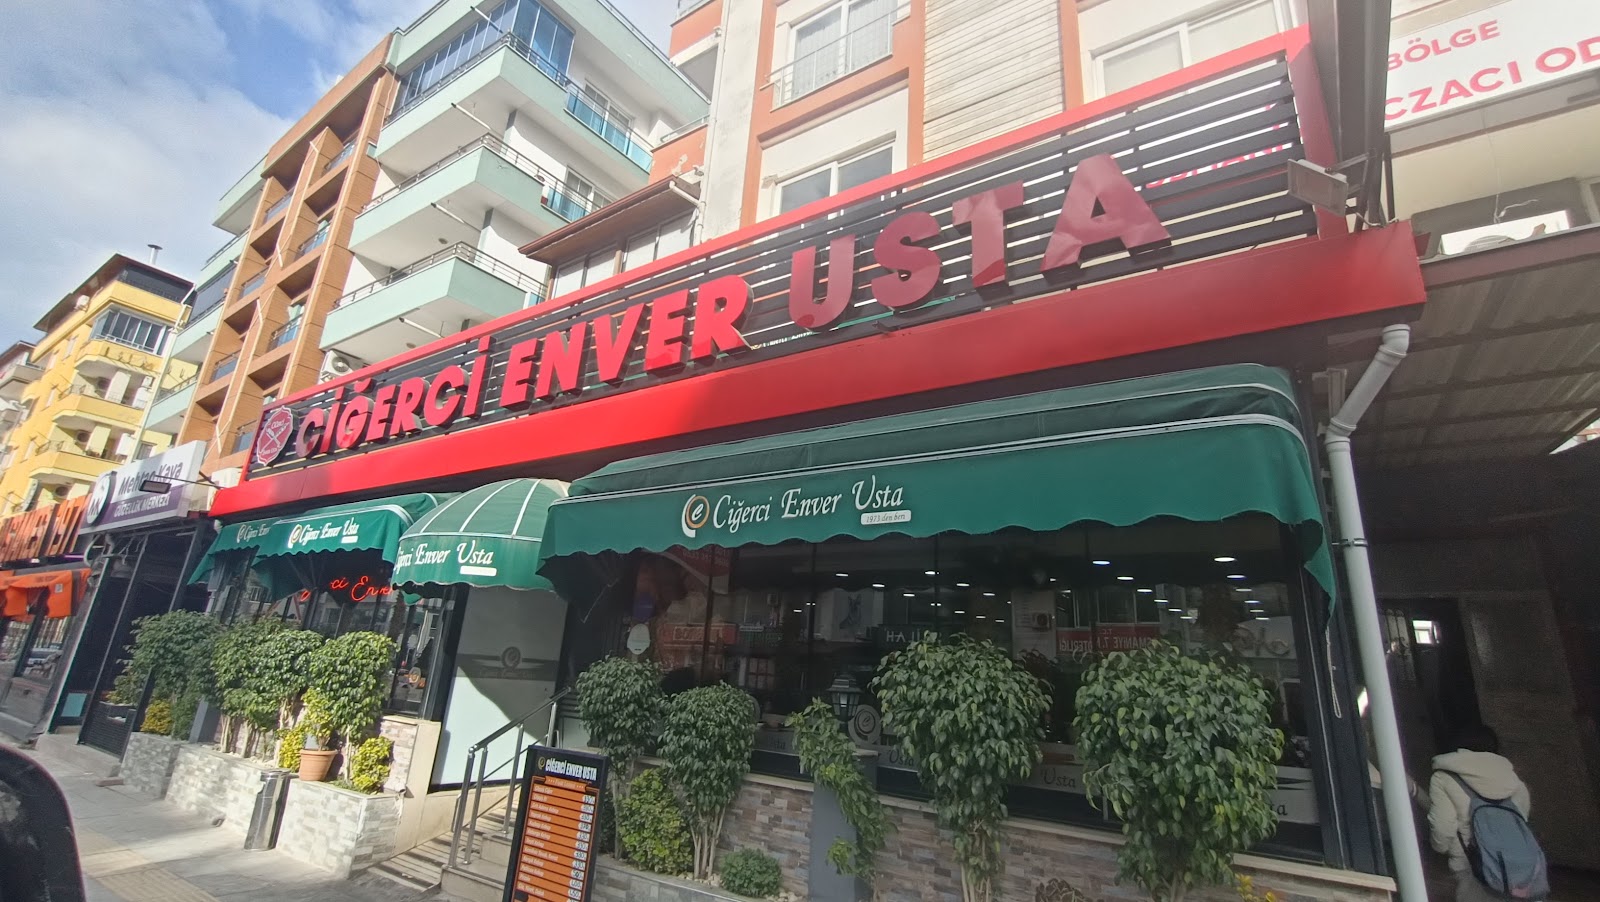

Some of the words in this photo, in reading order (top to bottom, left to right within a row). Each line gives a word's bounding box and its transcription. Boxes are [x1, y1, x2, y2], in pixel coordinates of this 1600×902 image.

[1388, 20, 1500, 72] BÖLGE
[296, 336, 494, 458] CİĞERCİ
[499, 274, 753, 409] ENVER
[789, 153, 1171, 331] USTA
[713, 494, 772, 533] Ciğerci
[781, 488, 842, 519] Enver
[852, 475, 903, 510] Usta
[866, 514, 880, 523] 1973
[415, 543, 450, 565] Enver
[456, 539, 494, 564] Usta
